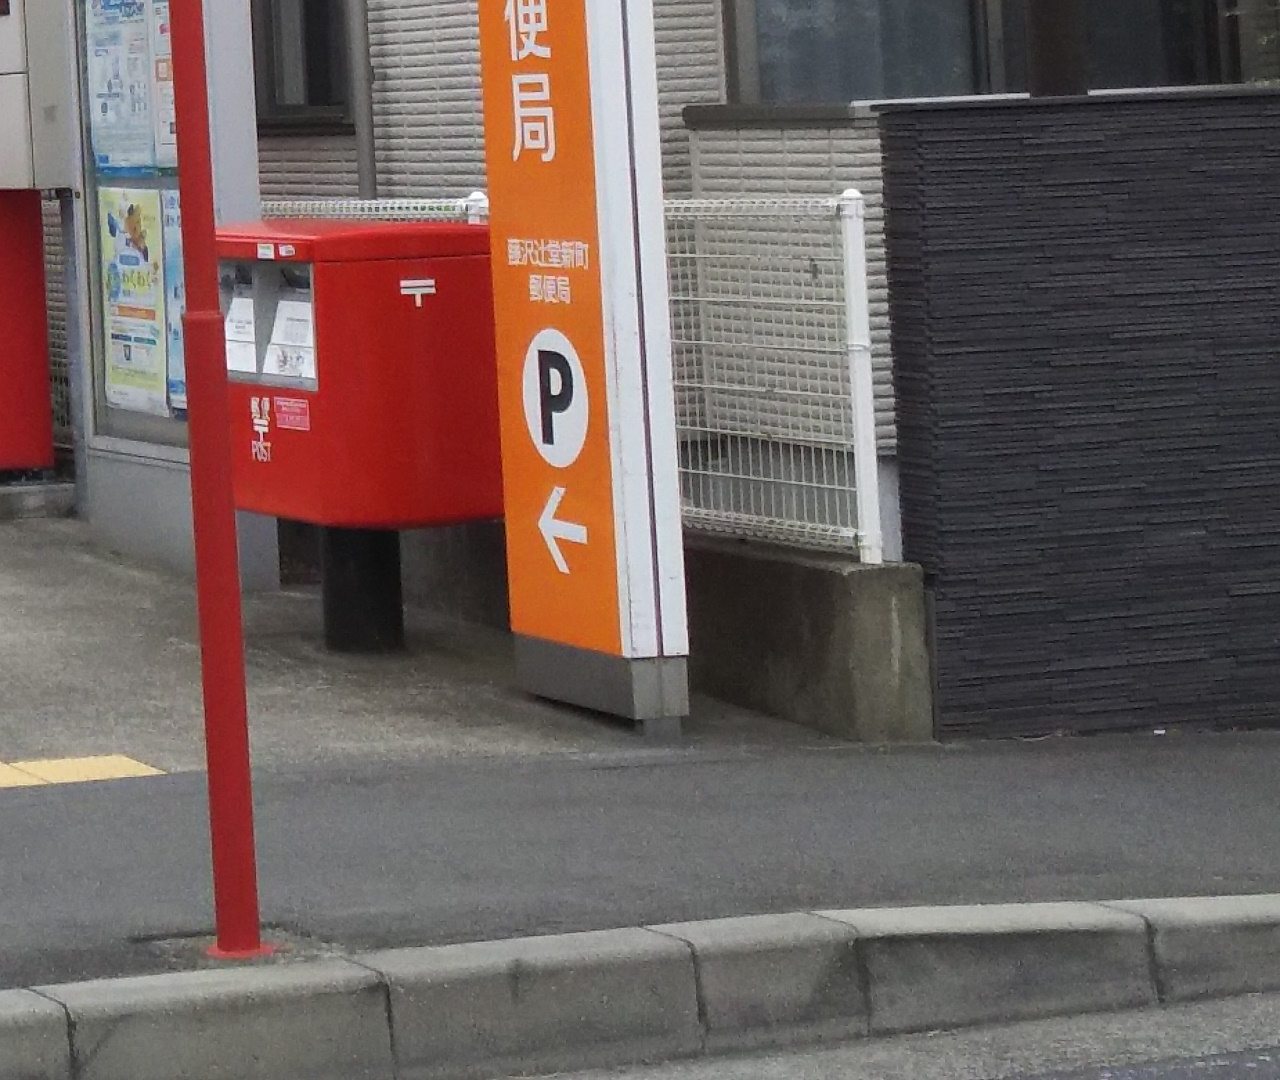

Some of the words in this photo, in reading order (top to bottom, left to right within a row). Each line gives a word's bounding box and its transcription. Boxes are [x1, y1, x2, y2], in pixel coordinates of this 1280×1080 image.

[507, 238, 589, 270] 藤沢辻堂新町
[529, 274, 571, 305] 郵便局
[536, 347, 575, 446] P
